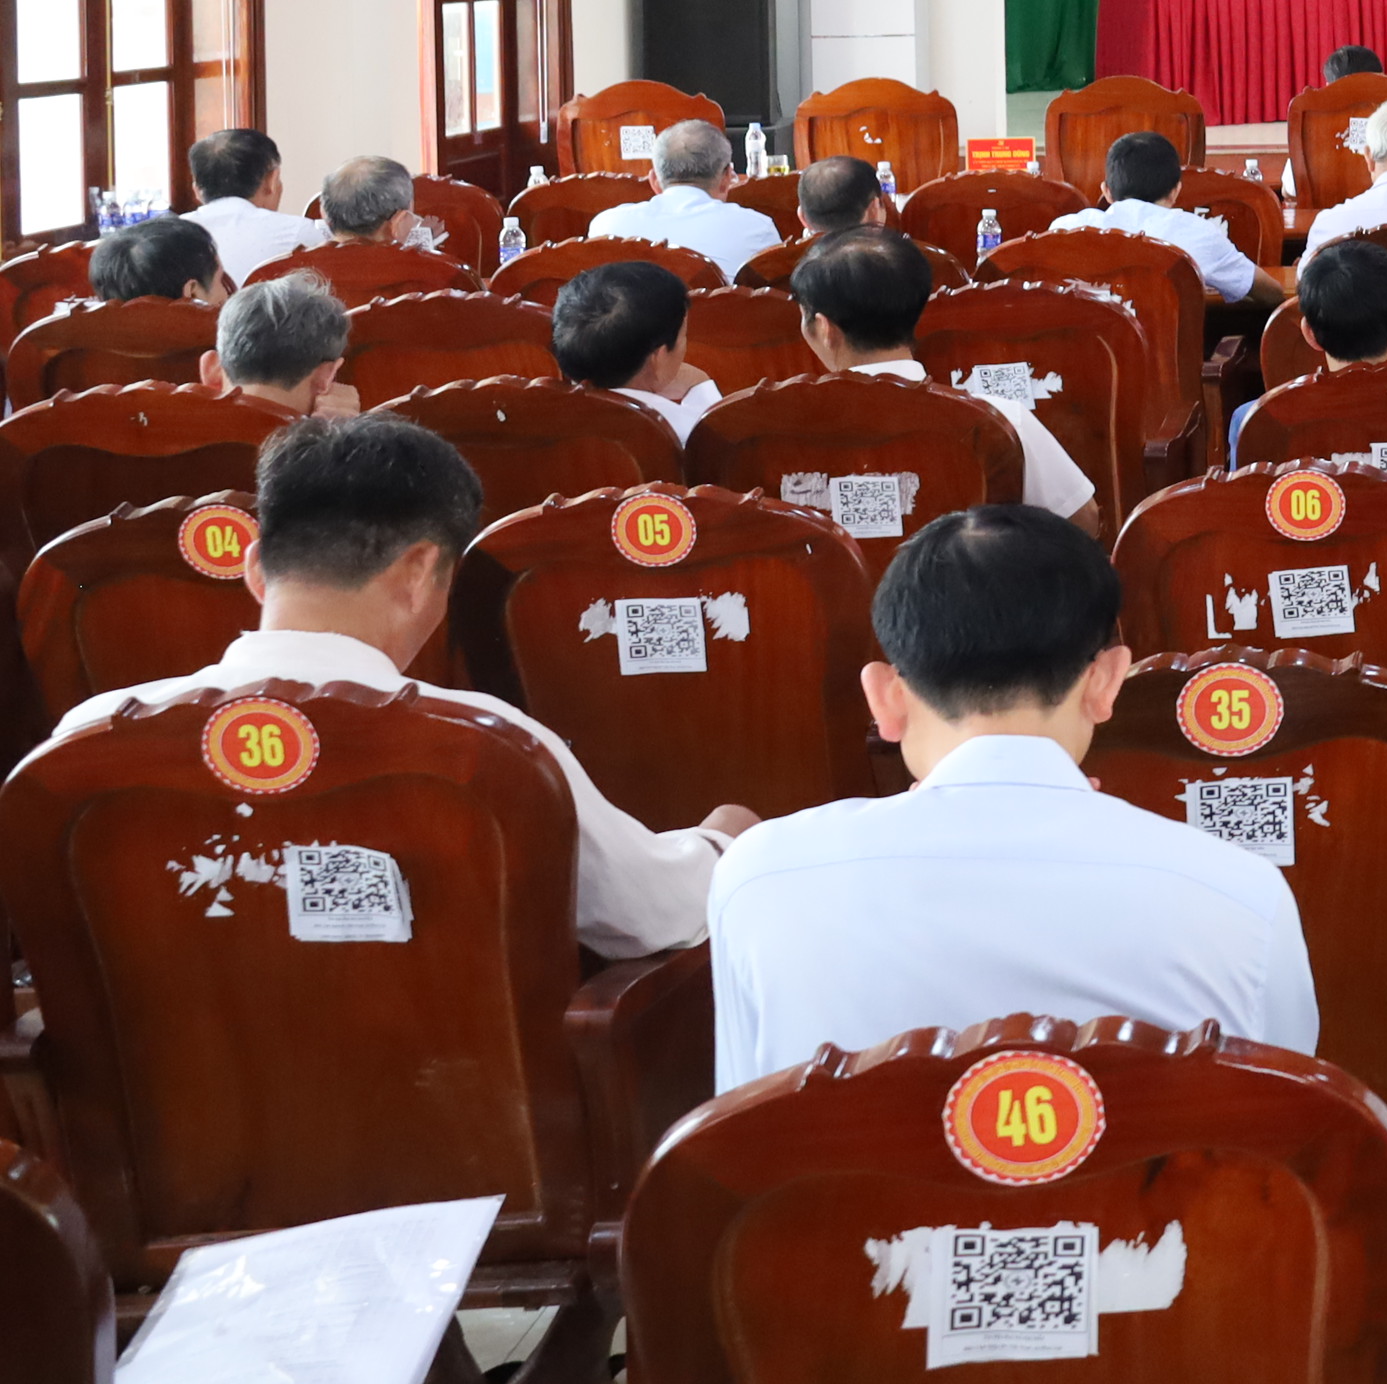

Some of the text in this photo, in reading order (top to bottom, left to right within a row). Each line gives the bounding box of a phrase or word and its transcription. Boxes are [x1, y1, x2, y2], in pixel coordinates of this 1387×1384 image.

[1291, 489, 1321, 520] 06
[205, 525, 241, 559] 04
[637, 514, 671, 546] 05
[1210, 689, 1252, 730] 35
[238, 723, 285, 768] 36
[996, 1085, 1058, 1147] 46
